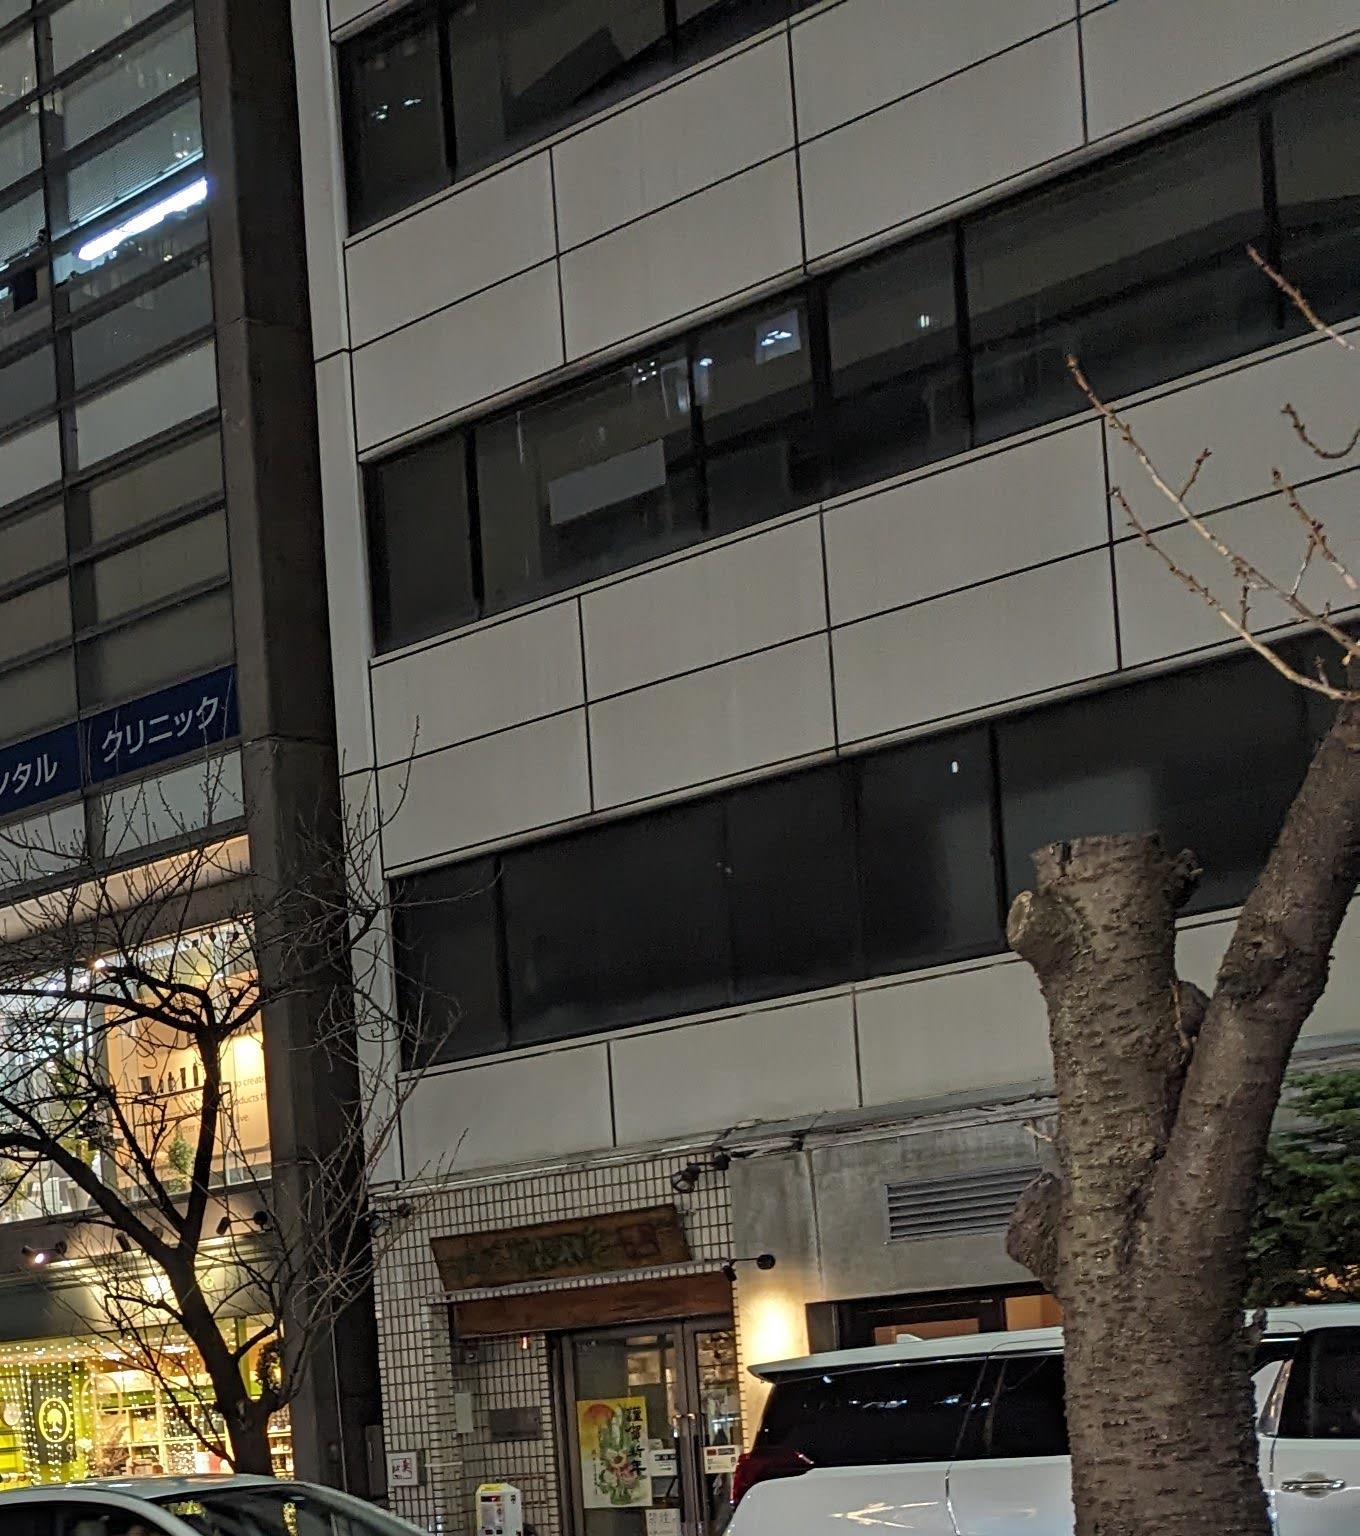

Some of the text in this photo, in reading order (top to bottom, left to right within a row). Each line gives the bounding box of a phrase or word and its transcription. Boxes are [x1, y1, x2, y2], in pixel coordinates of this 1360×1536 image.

[101, 695, 221, 763] クリニック
